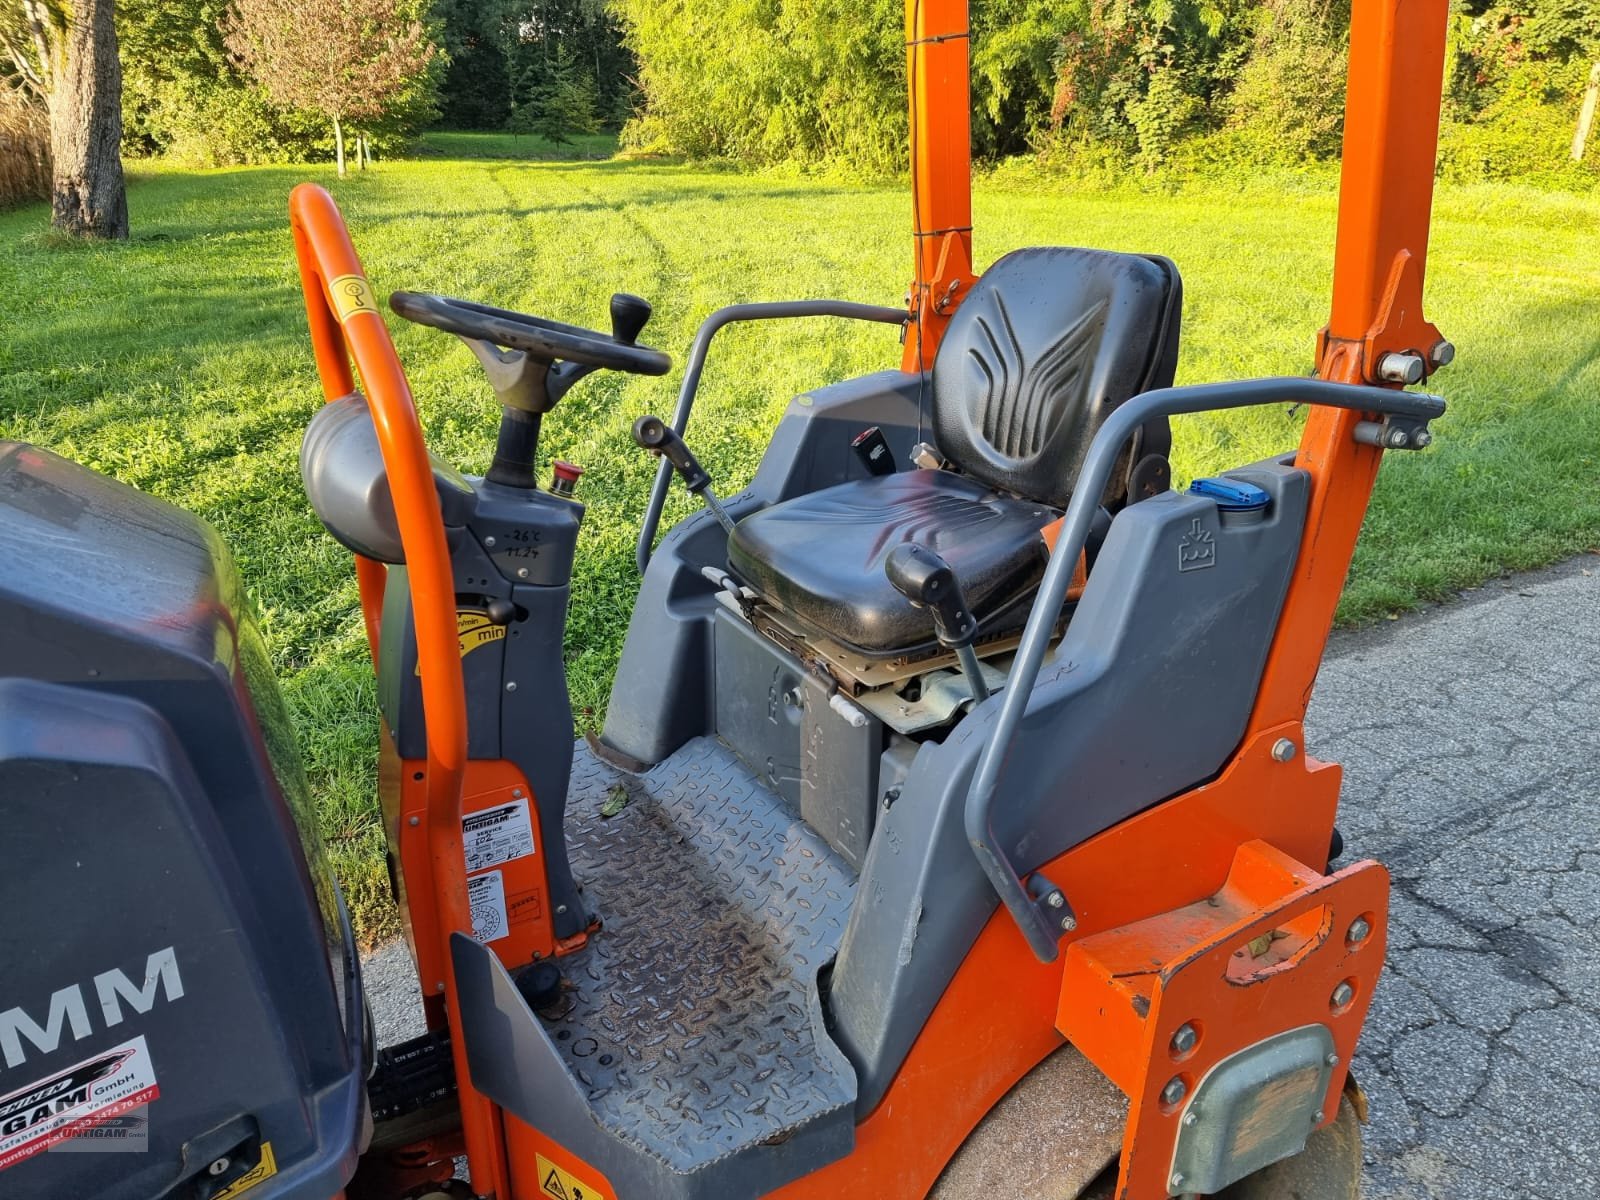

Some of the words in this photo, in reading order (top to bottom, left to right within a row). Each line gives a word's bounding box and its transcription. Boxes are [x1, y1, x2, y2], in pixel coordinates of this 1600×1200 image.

[477, 626, 504, 641] min
[94, 1073, 135, 1096] GmbH
[87, 1082, 145, 1110] Vermietung
[136, 1091, 152, 1103] 517
